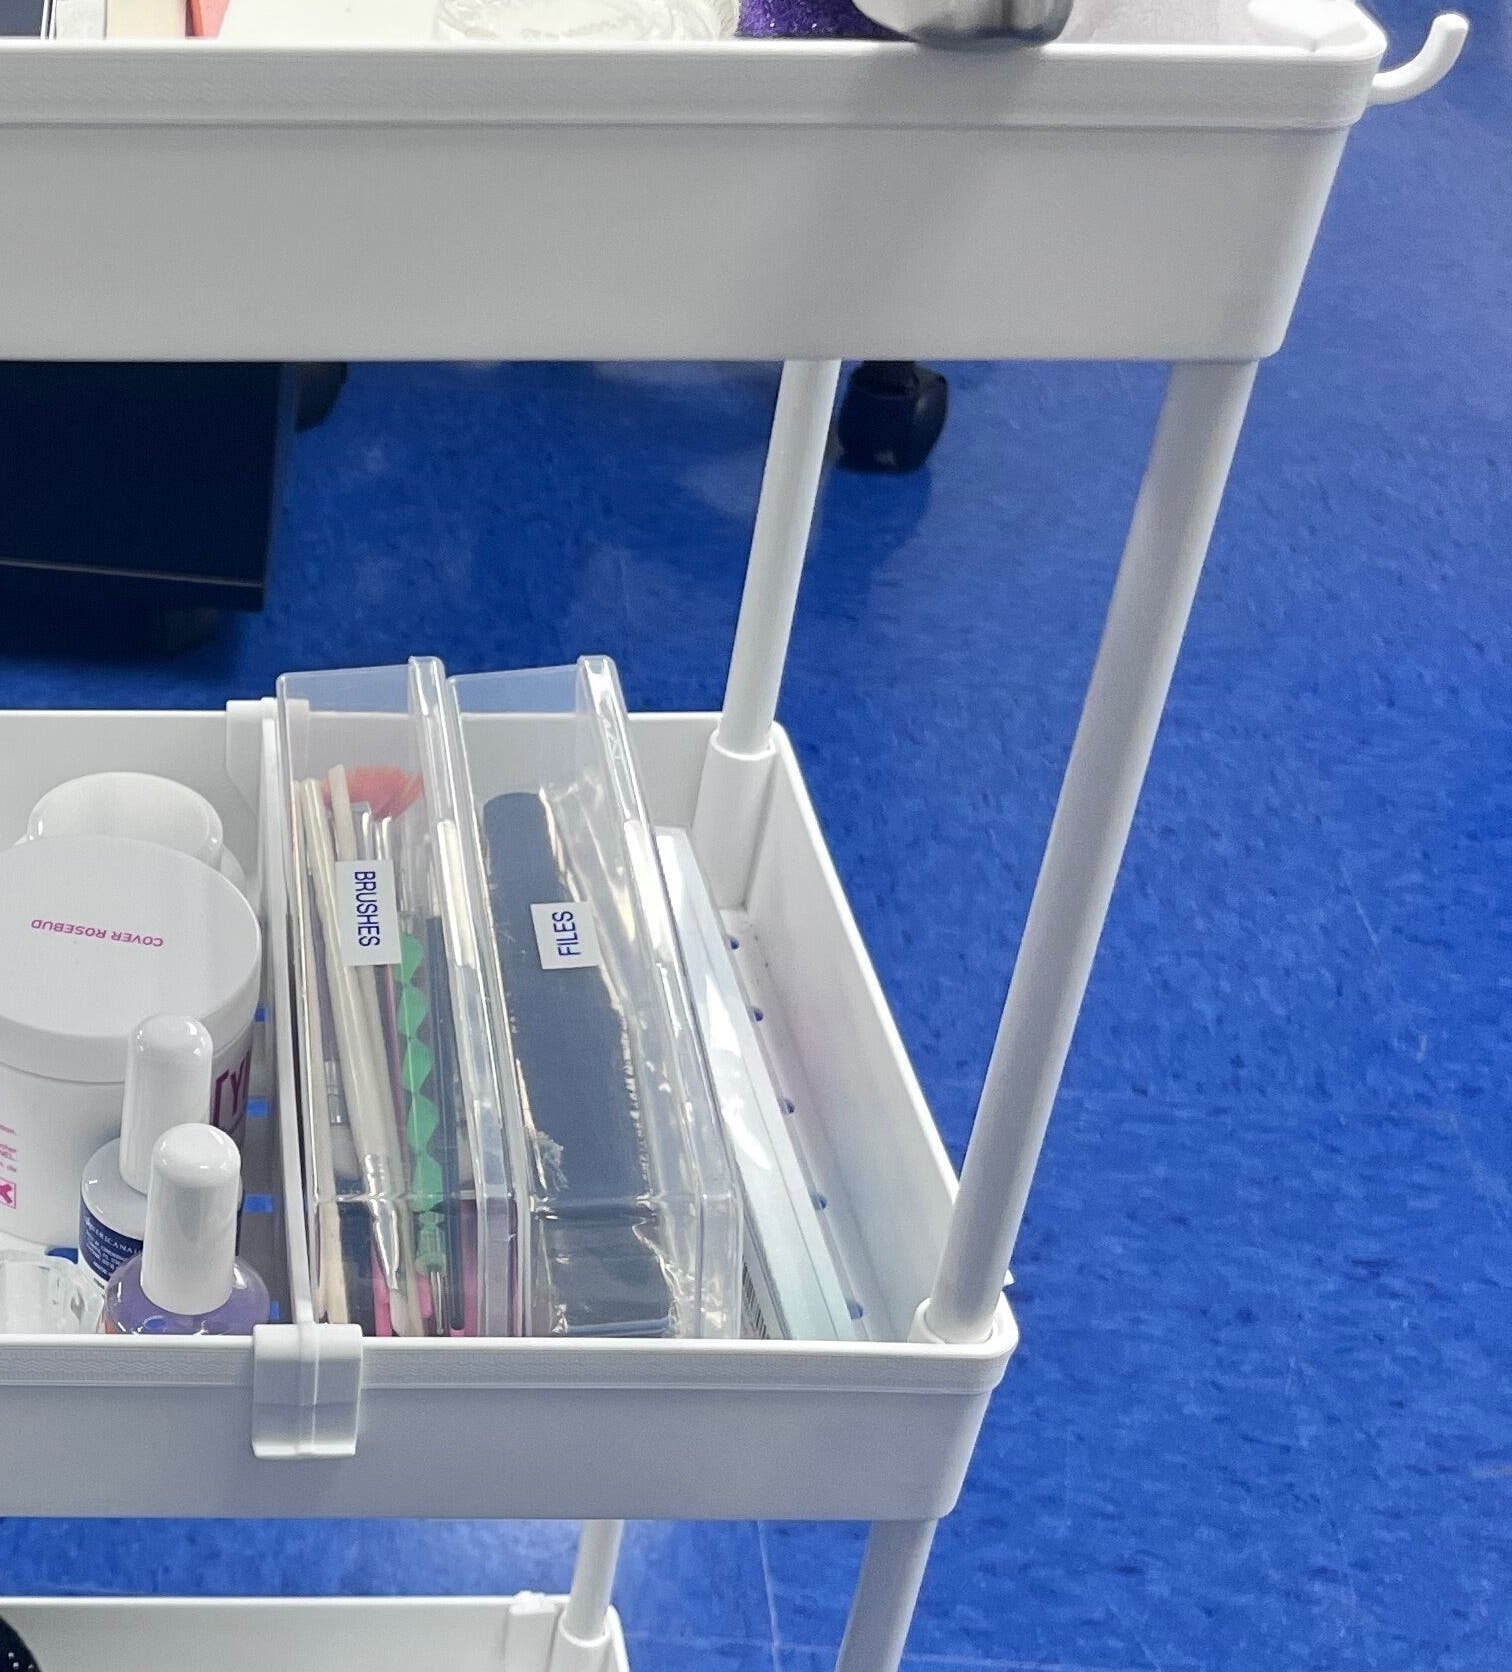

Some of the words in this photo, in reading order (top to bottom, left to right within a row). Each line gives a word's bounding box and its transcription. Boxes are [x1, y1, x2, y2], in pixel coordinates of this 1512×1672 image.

[354, 870, 381, 947] BRUSHES
[30, 918, 108, 940] ROSEBUD
[110, 930, 165, 948] COVER
[551, 910, 582, 956] FILES
